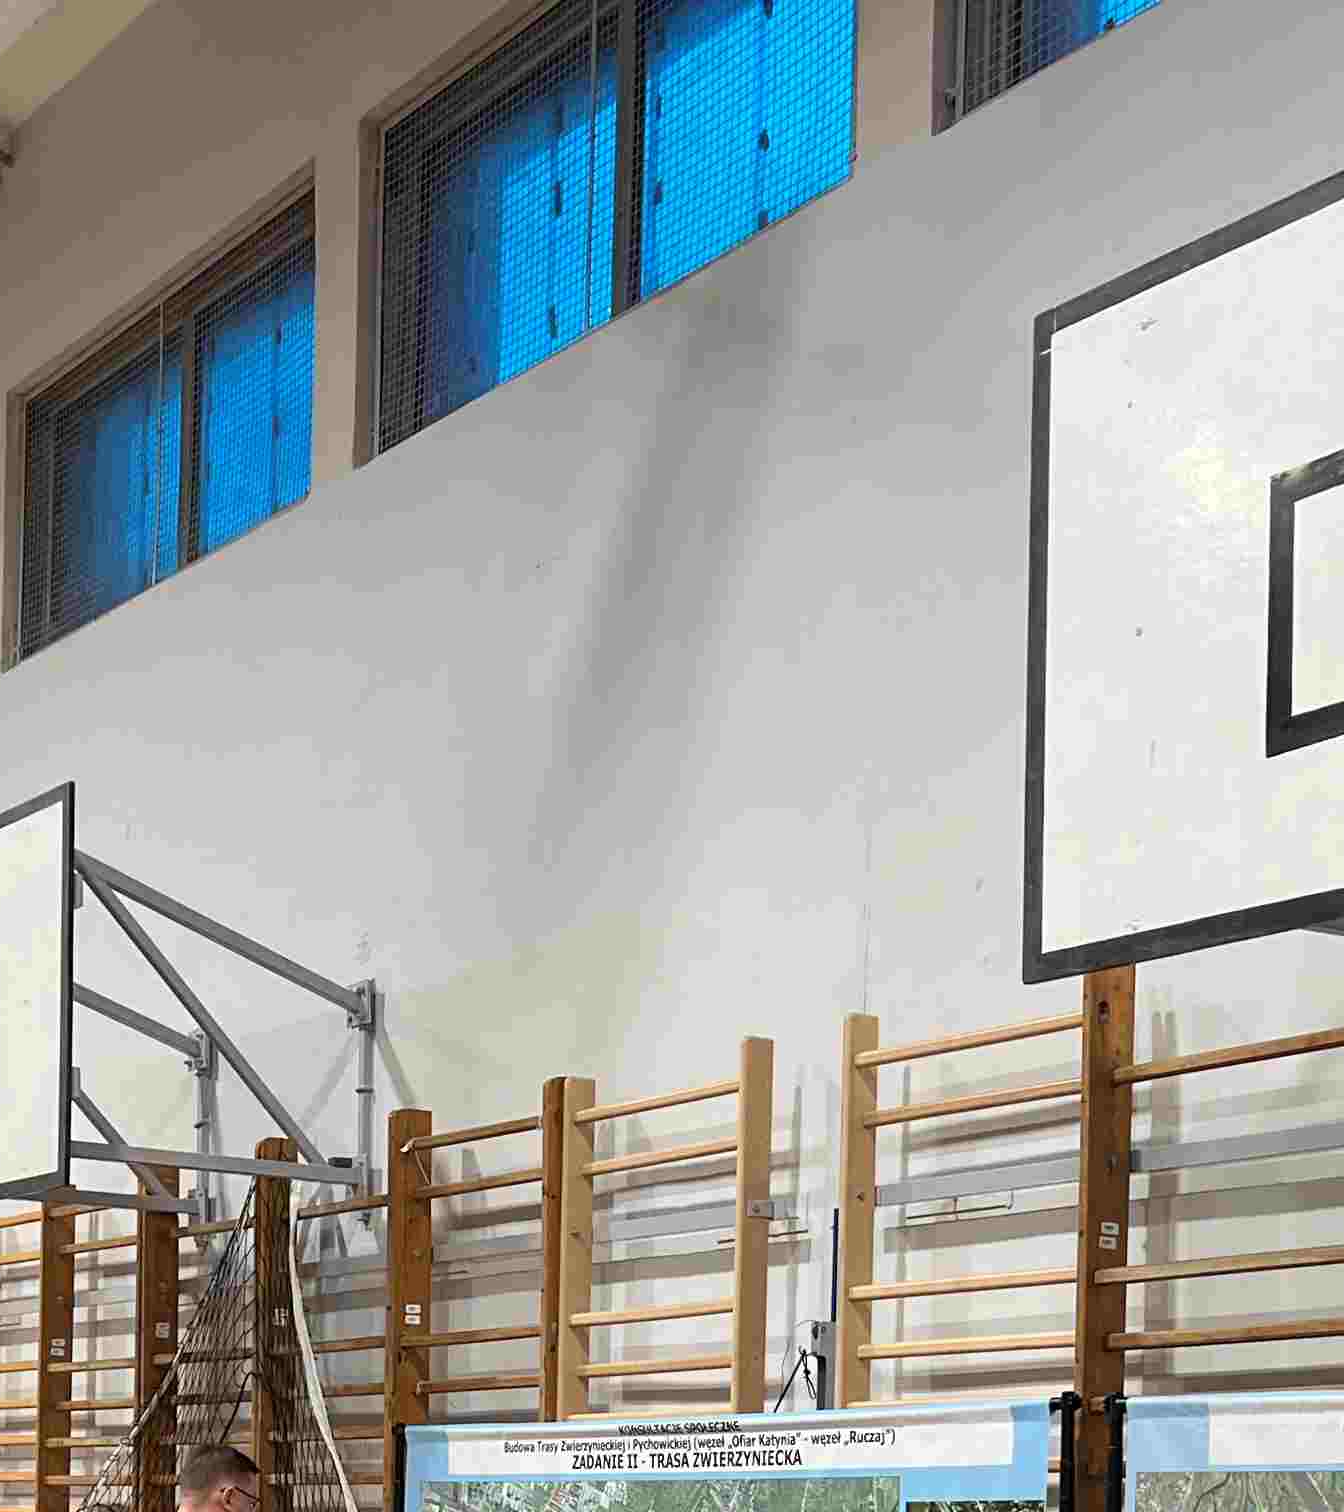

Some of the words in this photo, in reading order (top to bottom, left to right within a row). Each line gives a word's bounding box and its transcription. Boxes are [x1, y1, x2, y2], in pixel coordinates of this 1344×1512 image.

[504, 1441, 535, 1453] Budowa
[537, 1441, 558, 1455] Trasy
[572, 1453, 625, 1470] ZADANIE
[627, 1453, 638, 1469] II
[650, 1452, 690, 1469] TRASA
[693, 1449, 803, 1468] ZWIERZYNIECKA
